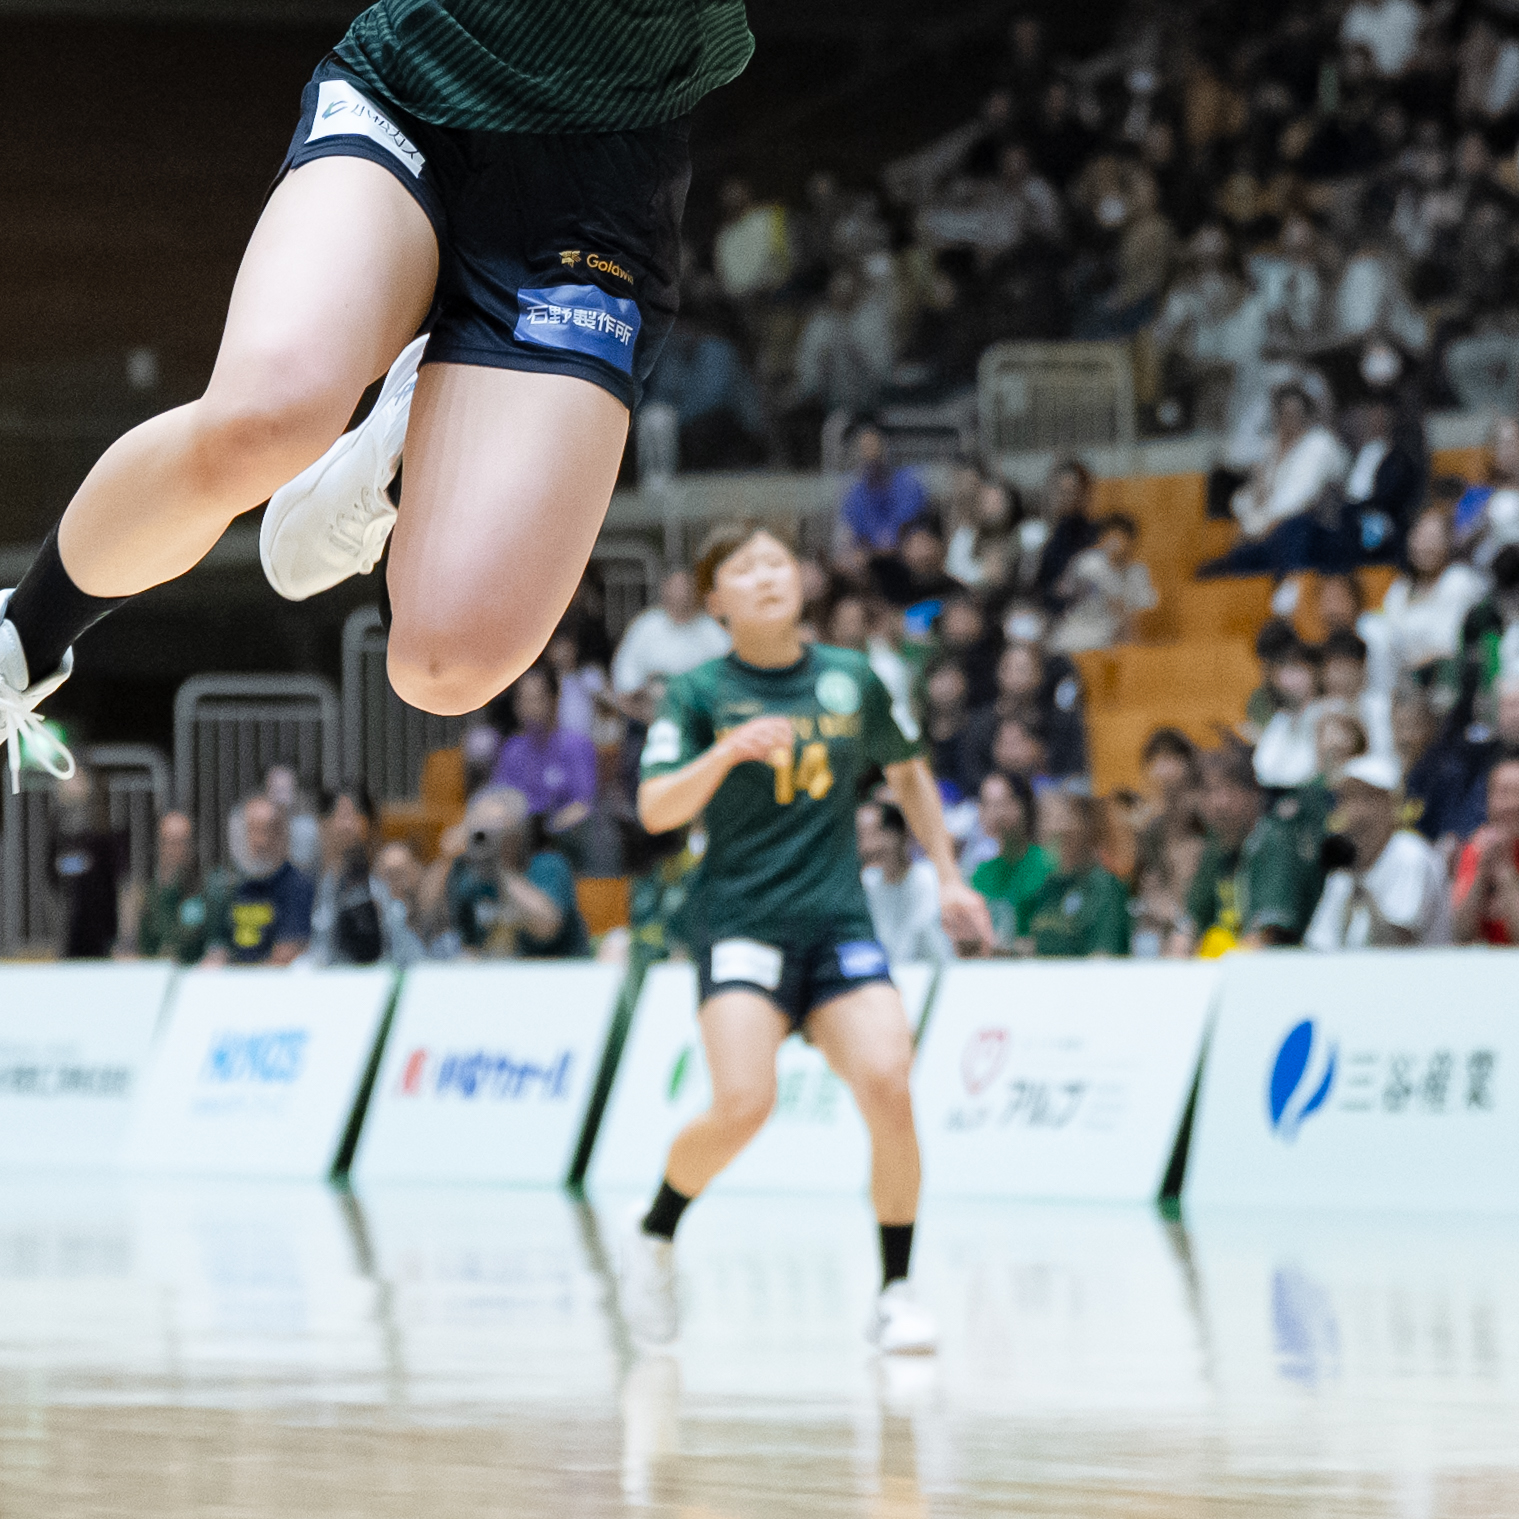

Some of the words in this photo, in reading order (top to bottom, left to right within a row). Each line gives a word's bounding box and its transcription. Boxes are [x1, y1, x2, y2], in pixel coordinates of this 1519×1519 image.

[526, 304, 634, 346] 石野製作所
